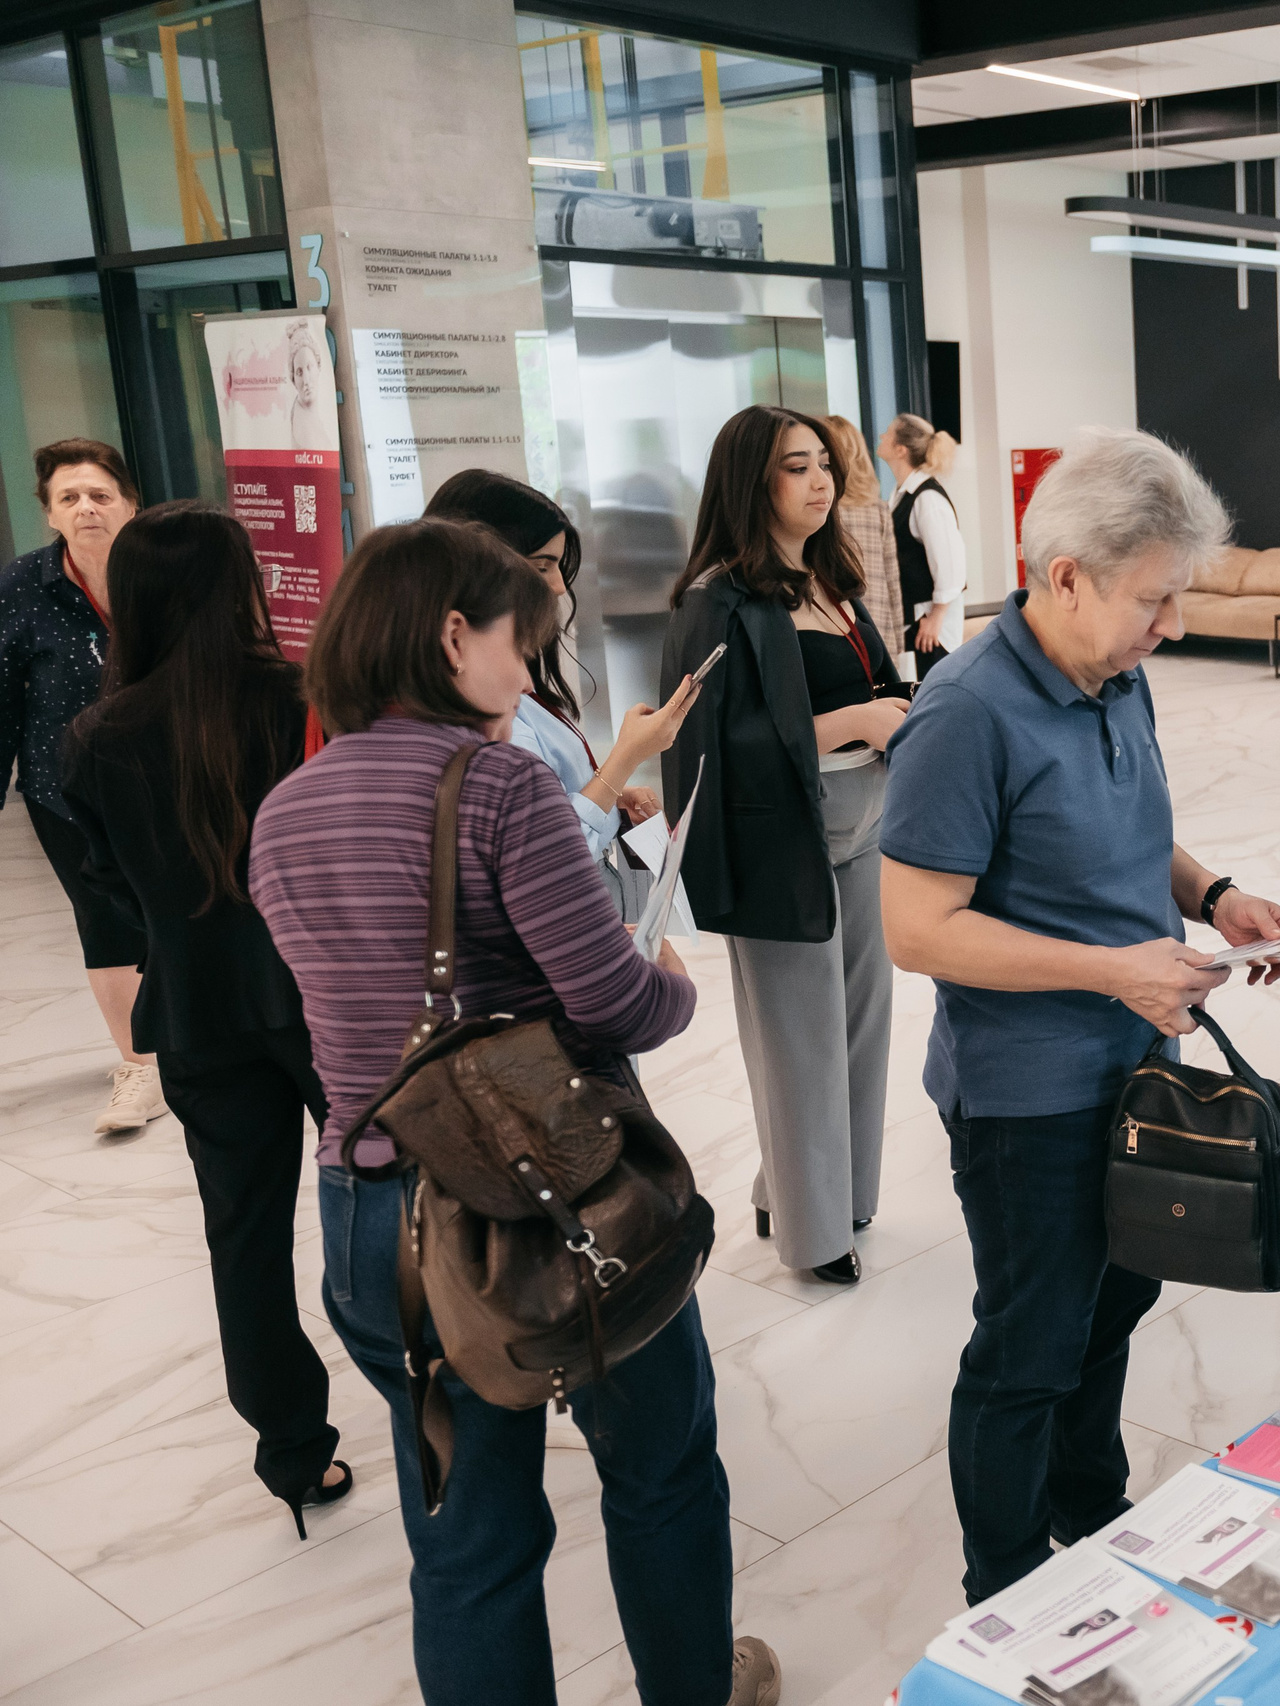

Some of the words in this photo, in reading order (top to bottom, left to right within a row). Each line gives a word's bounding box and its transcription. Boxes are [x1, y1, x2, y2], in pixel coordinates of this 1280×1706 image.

[363, 247, 437, 260] СИМУЛЯЦИОННЫЕ
[439, 251, 471, 261] ПАЛАТЫ
[473, 254, 498, 263] 3.1-3.8
[300, 234, 330, 308] 3
[365, 265, 404, 274] КОМНАТА
[405, 268, 452, 276] ОЖИДАНИЯ
[367, 283, 397, 292] ТУАЛЕТ
[373, 331, 446, 341] СИМУЛЯЦИОННЫЕ
[448, 334, 479, 342] ПАЛАТЫ
[375, 350, 411, 358] КАБИНЕТ
[413, 351, 459, 359] ДИРЕКТОРА
[377, 368, 414, 376] КАБИНЕТ
[416, 368, 468, 377] ДЕБРИФИНГА
[379, 385, 485, 394] МНОГОФУНКЦИОНАЛЬНЫЙ
[487, 386, 501, 394] ЗАЛ
[385, 437, 457, 446] СИМУЛЯЦИОННЫЕ
[459, 437, 490, 445] ПАЛАТЫ
